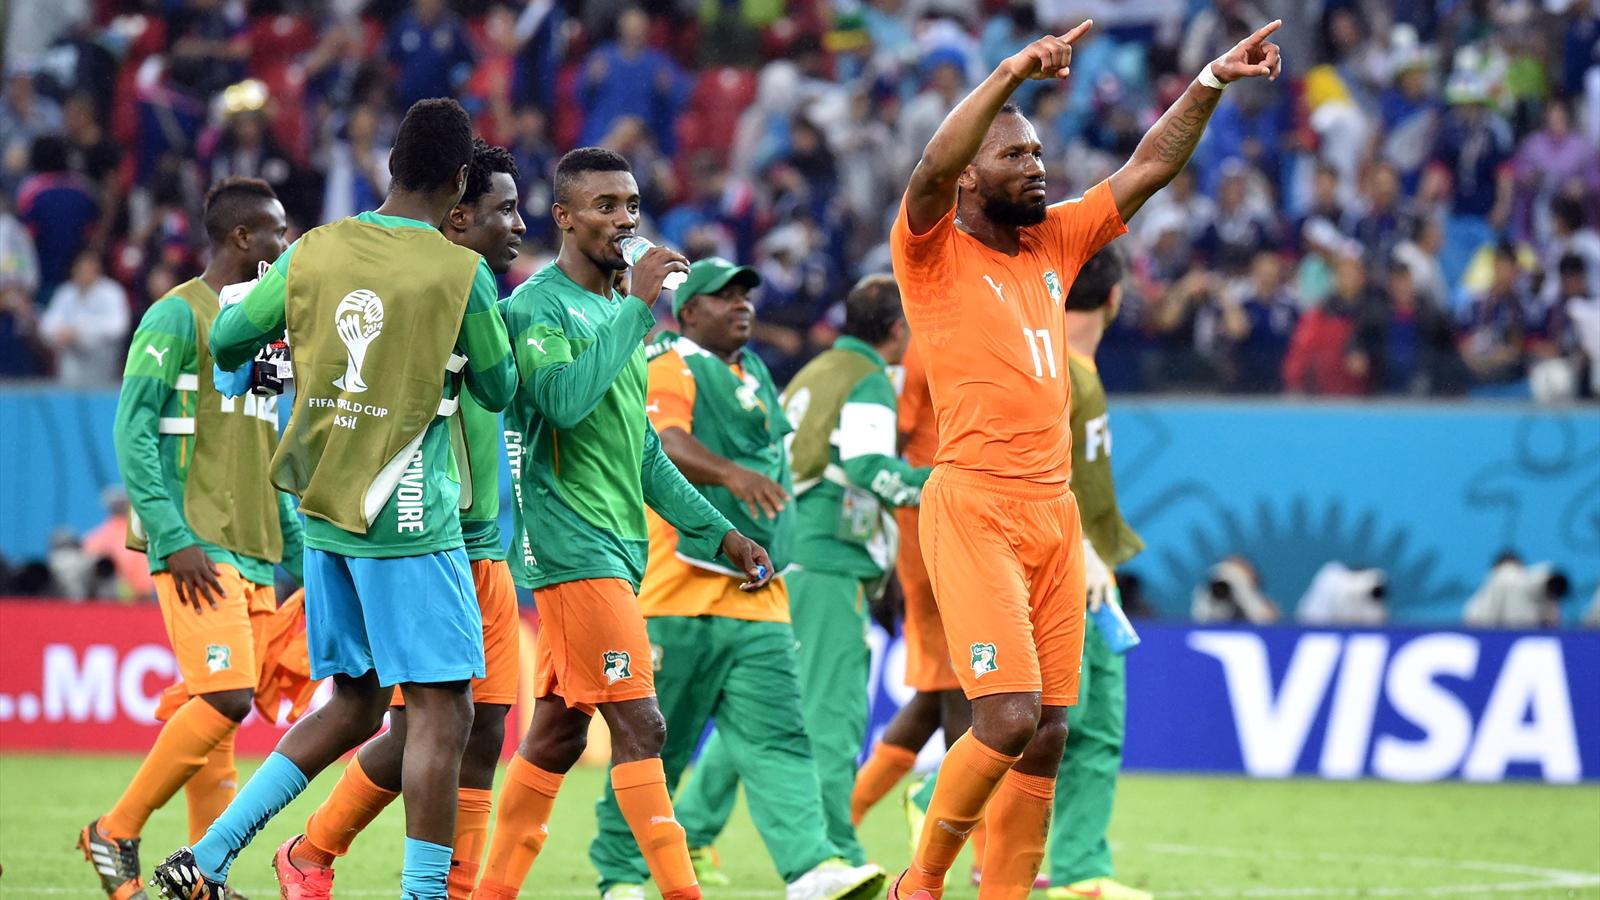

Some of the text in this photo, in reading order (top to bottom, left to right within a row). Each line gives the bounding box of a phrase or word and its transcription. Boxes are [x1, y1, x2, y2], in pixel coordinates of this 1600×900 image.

[362, 321, 383, 337] 2014
[1023, 327, 1056, 378] 11
[308, 398, 335, 407] FIFA
[363, 405, 389, 417] CUP
[1187, 631, 1582, 782] VISA
